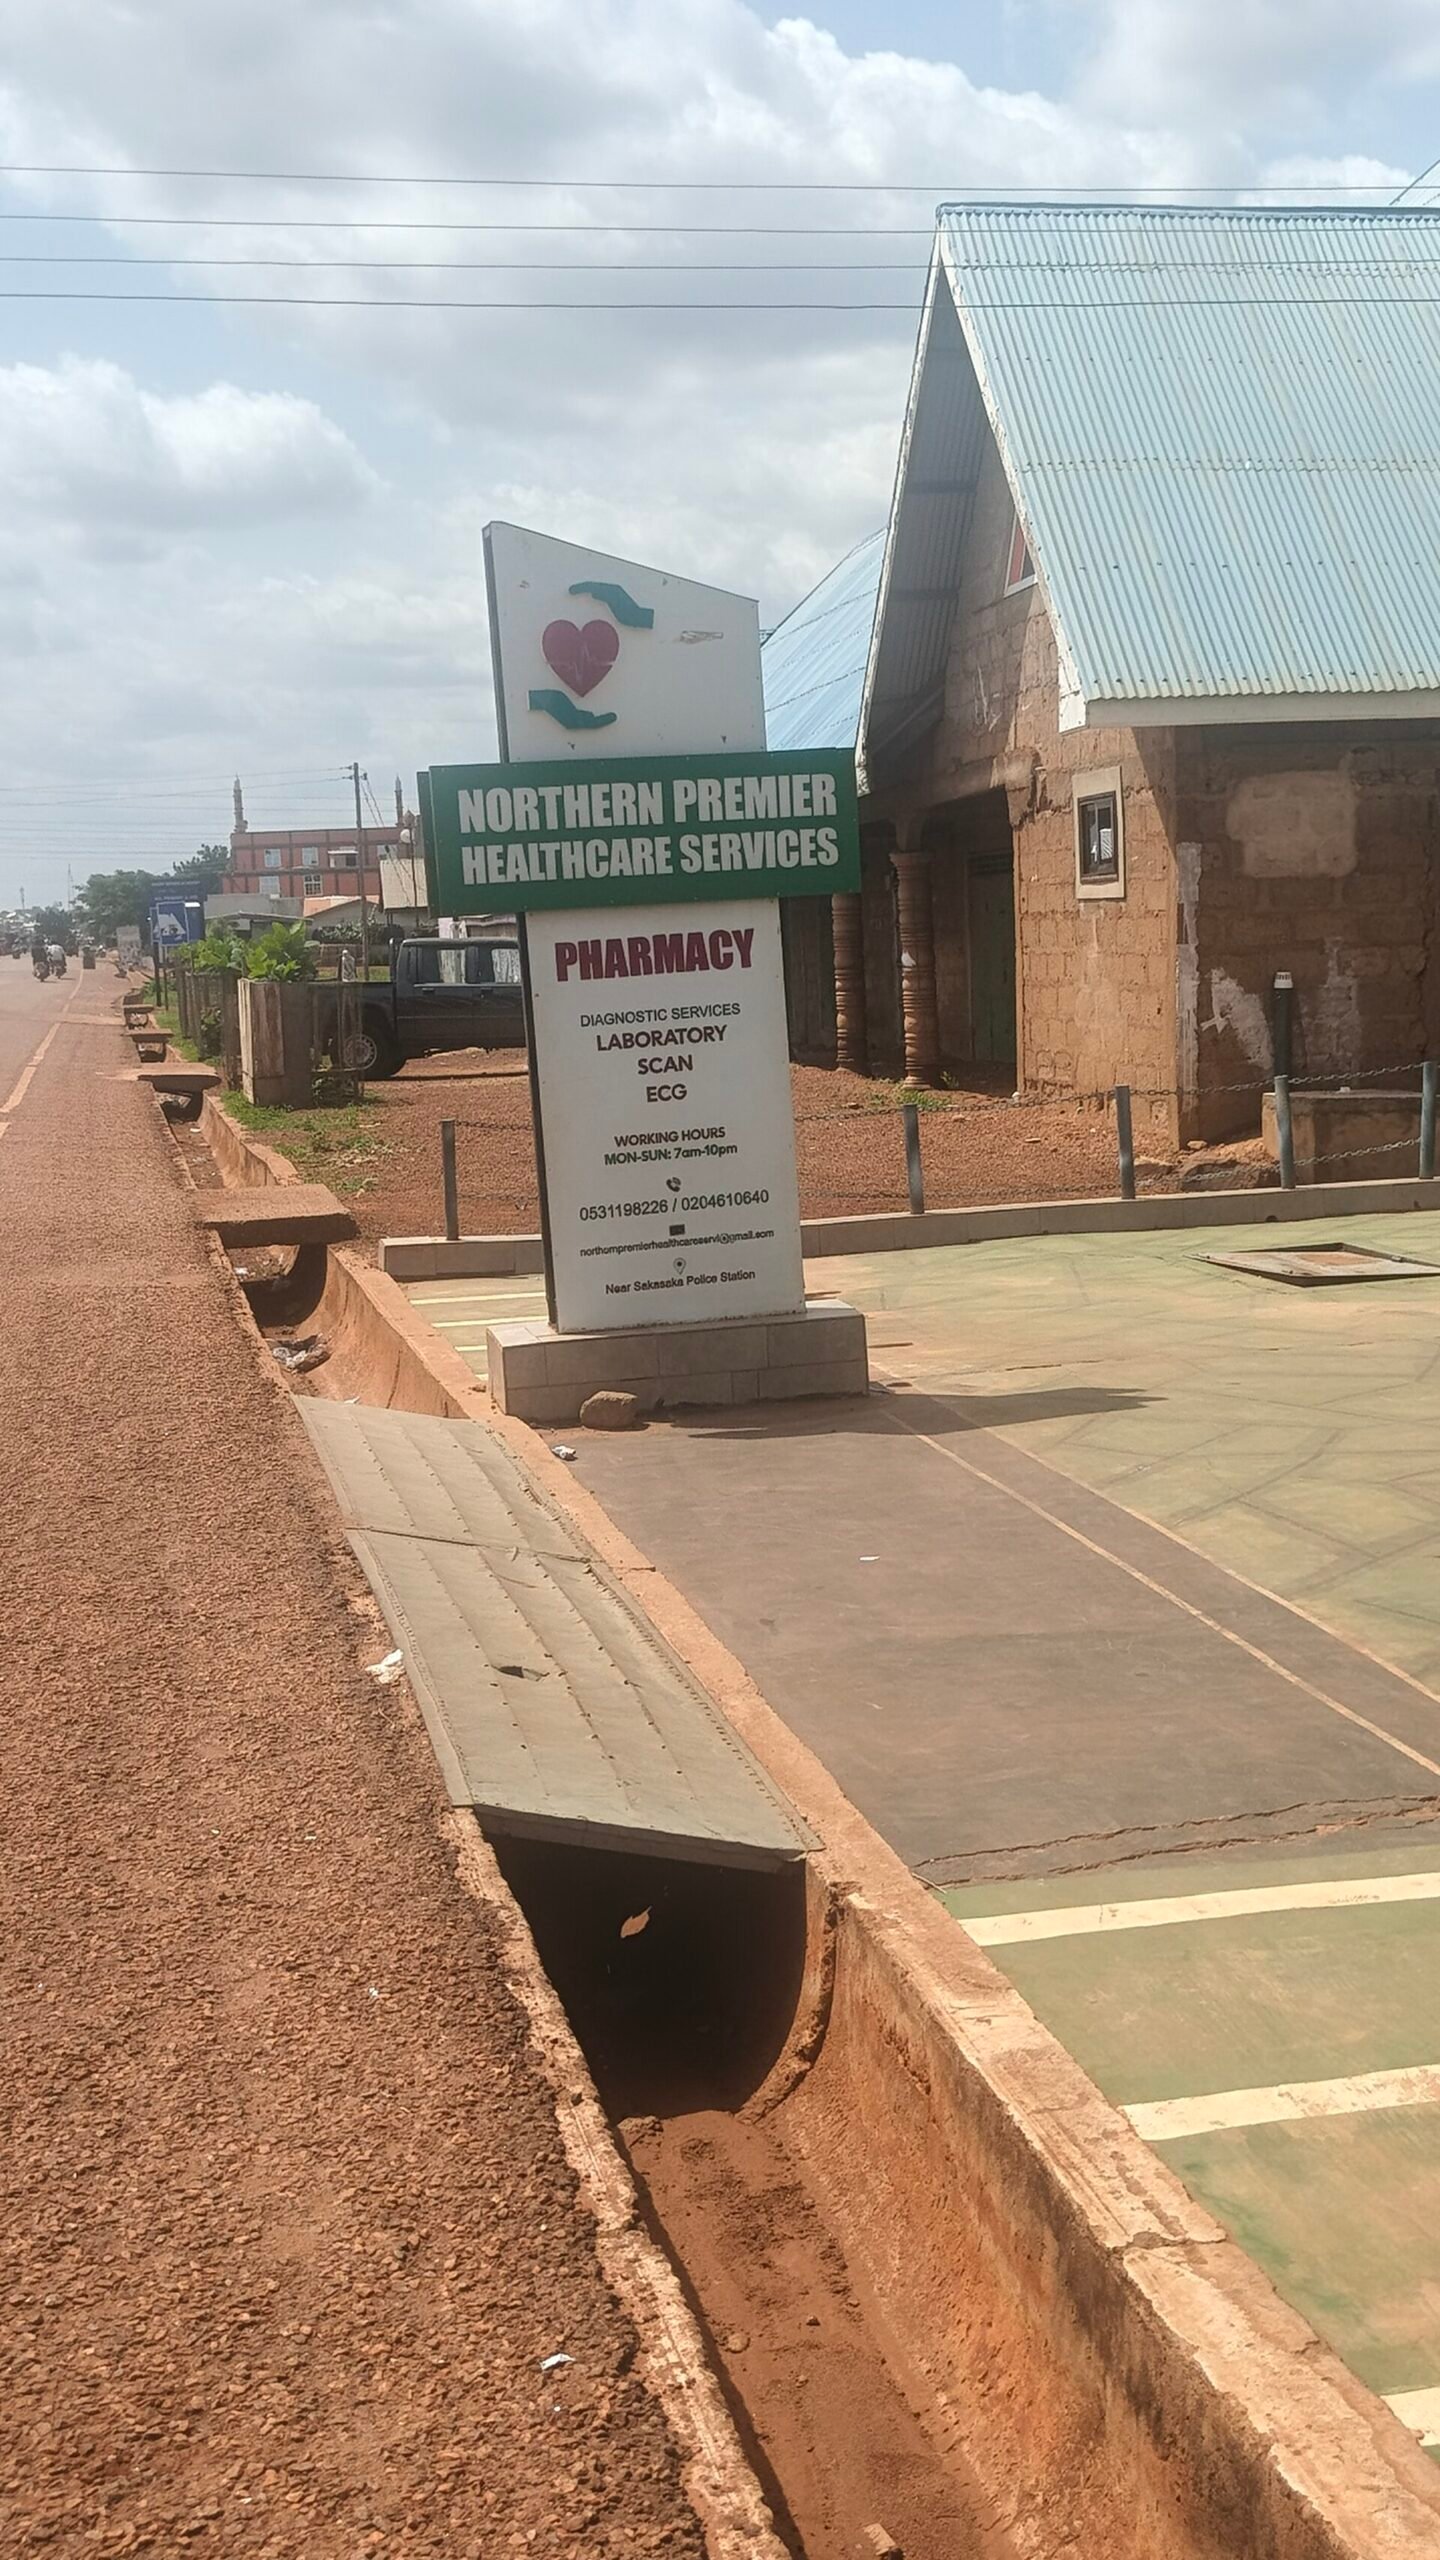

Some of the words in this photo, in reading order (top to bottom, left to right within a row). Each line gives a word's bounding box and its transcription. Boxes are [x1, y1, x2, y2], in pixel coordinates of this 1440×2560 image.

[457, 781, 664, 834] NORTHERN
[673, 773, 838, 823] PREMIER
[461, 836, 674, 885] HEALTHCARE
[680, 827, 839, 874] SERVICES
[554, 928, 755, 982] PHARMACY
[580, 1008, 668, 1027] DIAGNOSTIC
[671, 1003, 741, 1020] SERVICES
[596, 1024, 728, 1051] LABORATORY
[637, 1054, 694, 1075] SCAN
[646, 1083, 688, 1103] ECG
[614, 1131, 680, 1147] WORKING
[681, 1126, 726, 1142] HOURS
[604, 1148, 672, 1166] MON-SUN:
[673, 1143, 738, 1160] 7am-10pm
[579, 1199, 669, 1221] 0531198226
[672, 1198, 678, 1213] /
[681, 1189, 770, 1211] 0204610640
[605, 1283, 632, 1295] Near
[633, 1277, 685, 1292] Sakasaka
[686, 1273, 718, 1286] Police
[720, 1269, 756, 1283] Station
